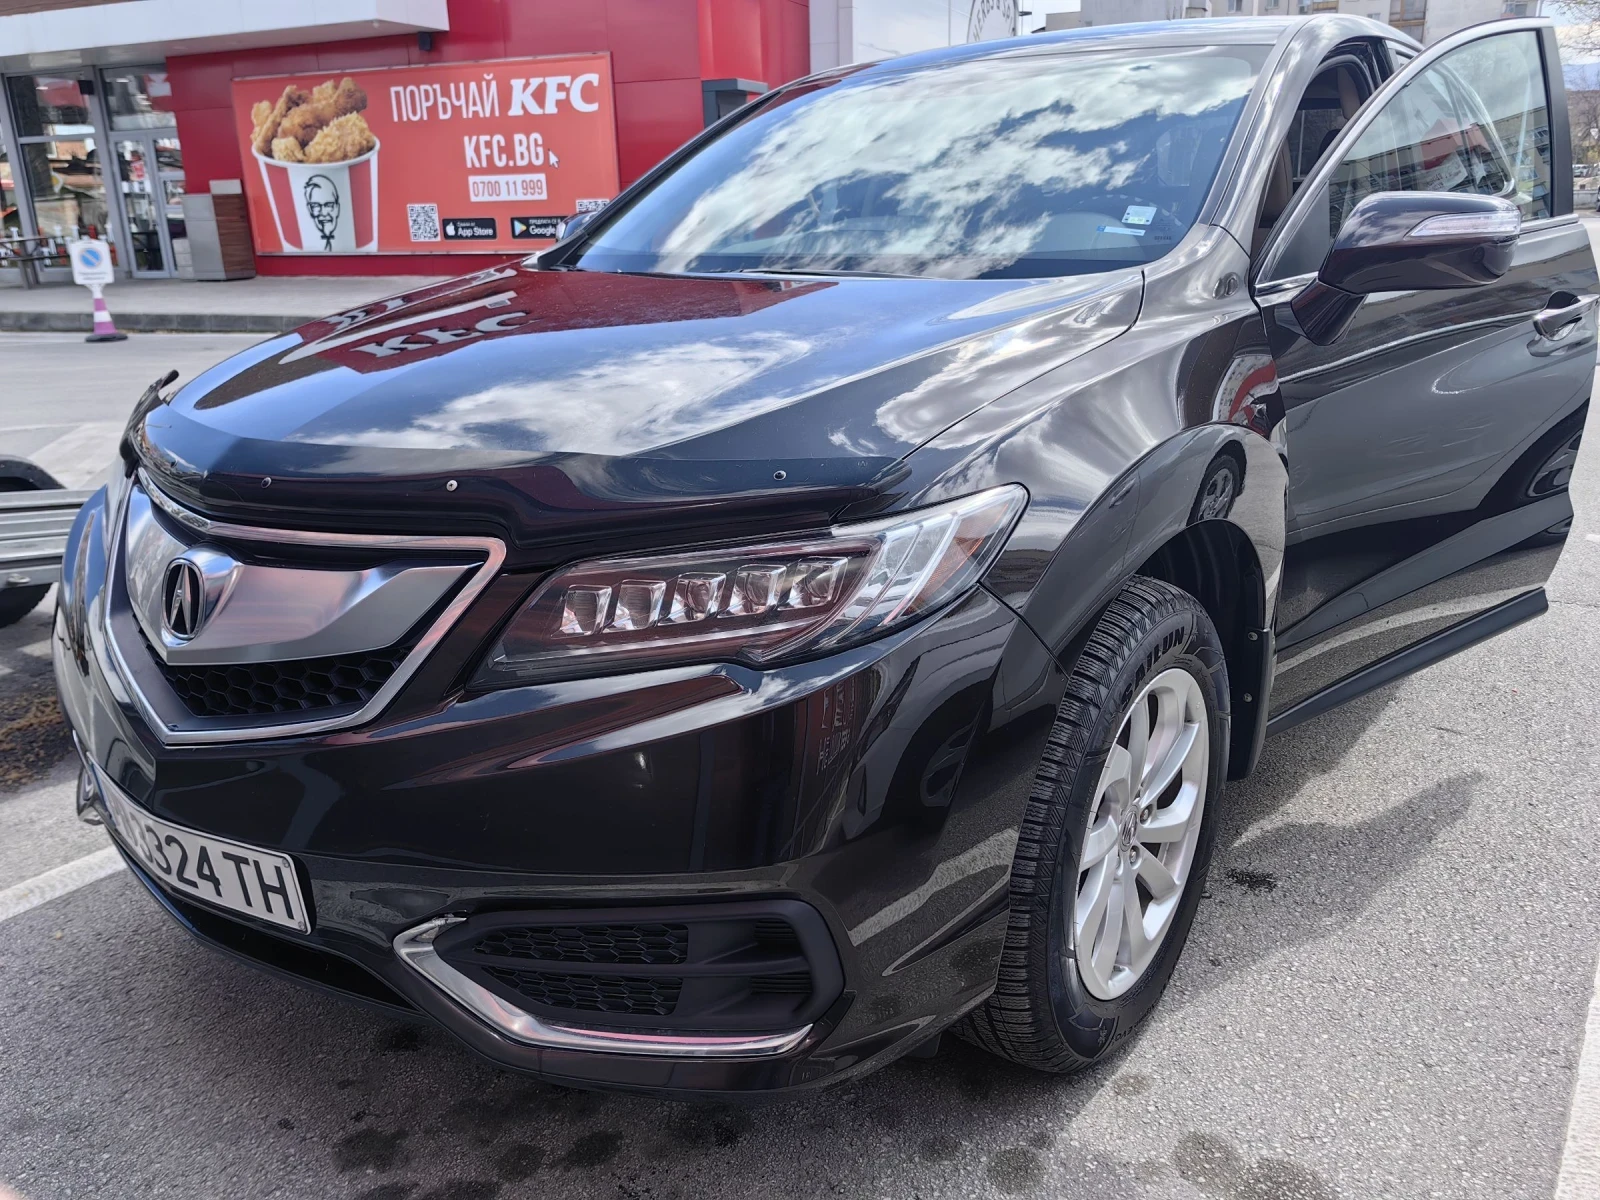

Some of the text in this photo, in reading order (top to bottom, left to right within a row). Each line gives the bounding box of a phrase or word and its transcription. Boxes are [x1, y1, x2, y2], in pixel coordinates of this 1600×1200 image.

[389, 73, 600, 122] ПОРЪЧАЙ KFC
[463, 132, 545, 168] KFC.BG
[472, 179, 543, 197] 0700 11 999
[457, 226, 494, 238] App Store
[529, 225, 556, 237] Google
[221, 850, 295, 920] TH
